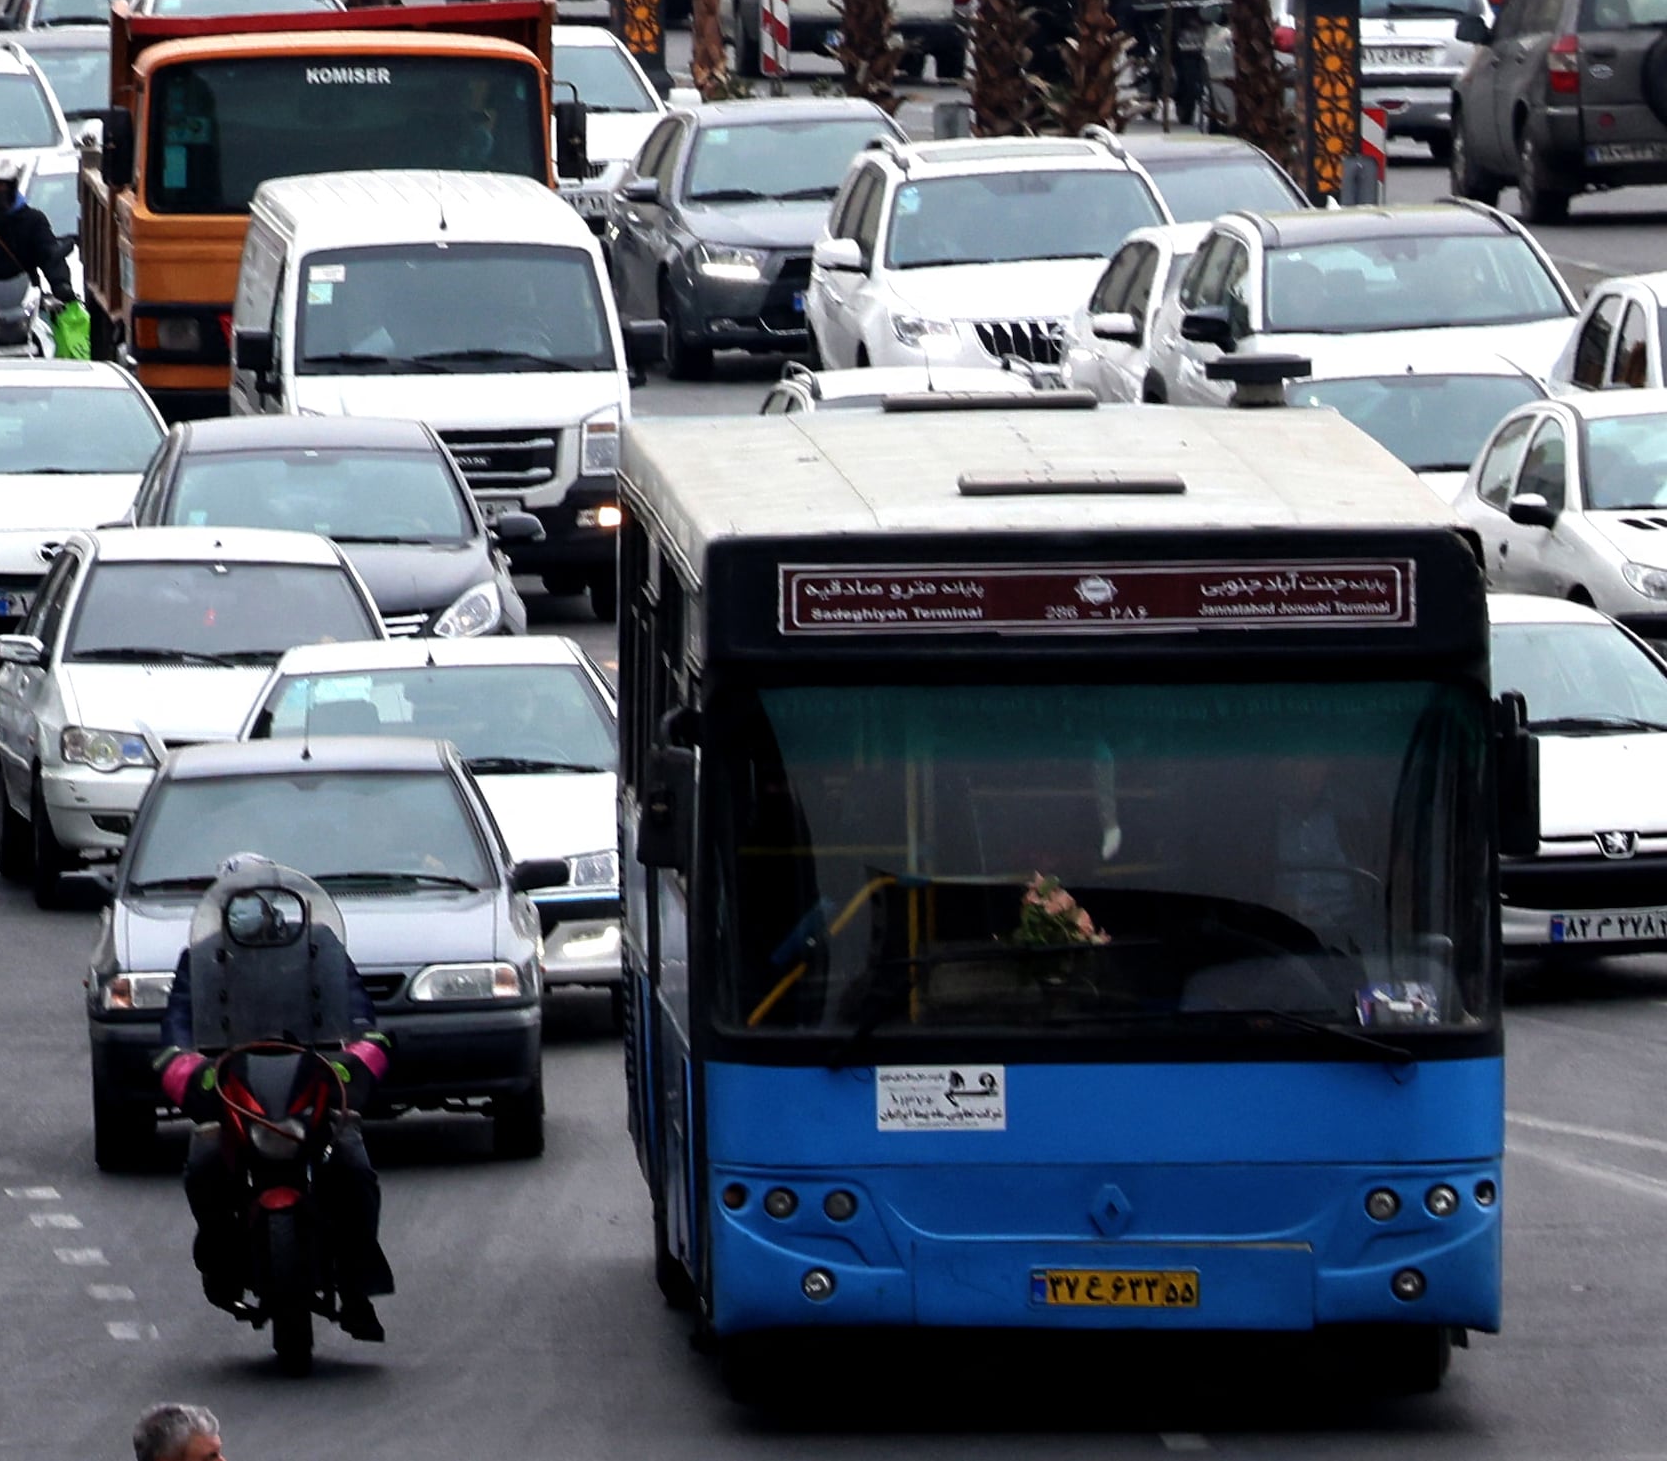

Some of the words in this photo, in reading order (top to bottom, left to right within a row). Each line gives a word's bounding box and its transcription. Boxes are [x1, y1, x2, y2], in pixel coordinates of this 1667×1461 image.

[306, 66, 392, 85] KOMISER
[803, 579, 885, 601] صادقیه
[1199, 576, 1264, 597] جنوبی
[810, 606, 909, 623] Sadeghiyeh
[911, 605, 984, 621] Terminal
[1334, 598, 1391, 614] Terminal
